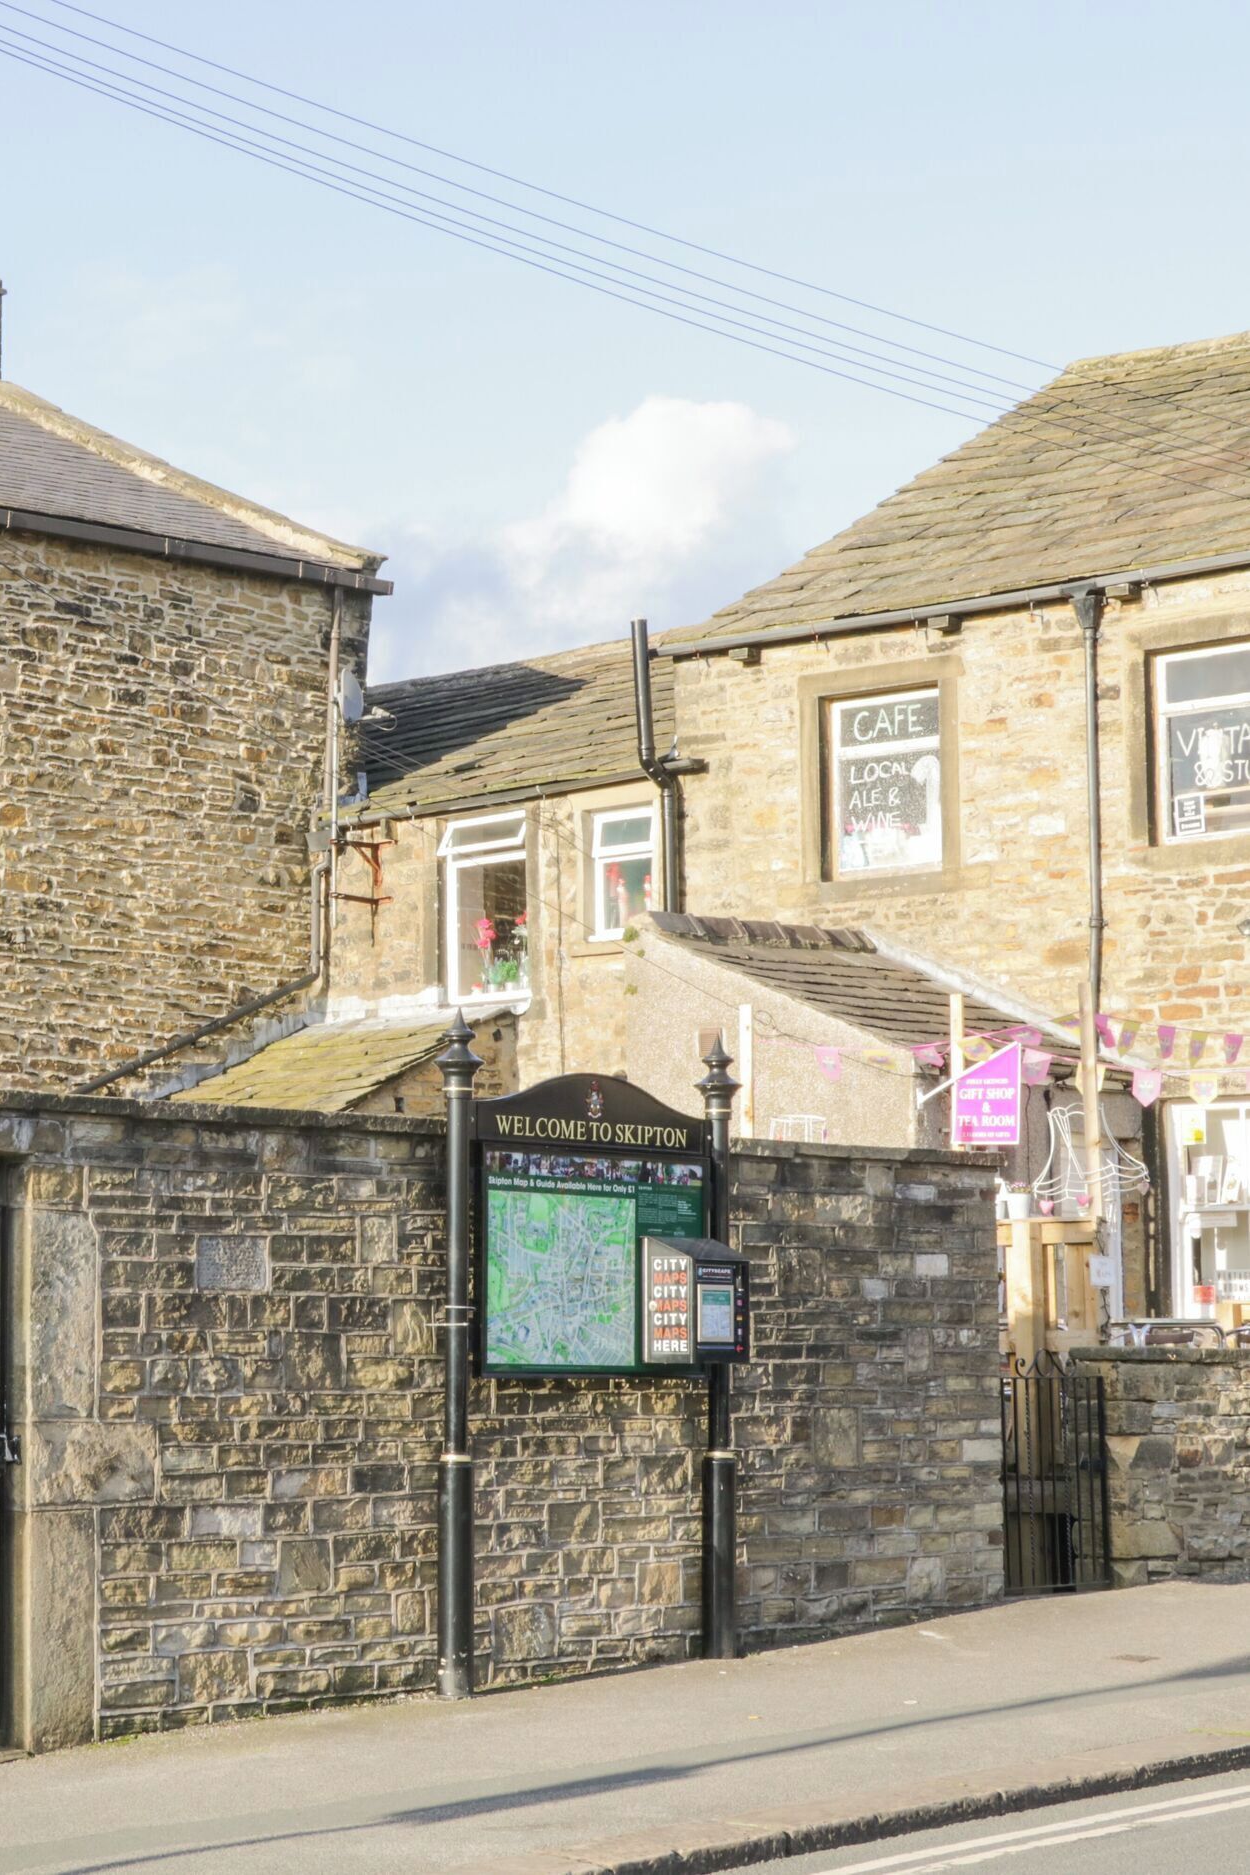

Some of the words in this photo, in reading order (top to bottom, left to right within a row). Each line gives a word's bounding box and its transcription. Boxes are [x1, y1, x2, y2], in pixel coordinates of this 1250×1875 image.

[853, 703, 923, 741] CAFE
[849, 760, 910, 784] LOCAL
[849, 787, 882, 810] ALE
[888, 786, 901, 807] &
[851, 811, 901, 833] WINE
[959, 1087, 984, 1100] GIFT
[986, 1087, 1015, 1100] SHOP
[981, 1101, 991, 1113] &
[958, 1115, 979, 1127] TEA
[981, 1115, 1015, 1127] ROOM
[495, 1114, 587, 1141] WELCOME
[588, 1122, 612, 1142] TO
[615, 1123, 688, 1148] SKIPTON
[488, 1175, 512, 1186] Skipton
[513, 1178, 529, 1188] Map
[530, 1179, 535, 1187] &
[536, 1179, 555, 1188] Guide
[556, 1181, 586, 1191] Available
[587, 1183, 602, 1192] Here
[603, 1183, 612, 1192] for
[613, 1184, 627, 1194] Only
[653, 1258, 687, 1271] CITY
[653, 1272, 687, 1284] MAPS
[653, 1285, 687, 1298] CITY
[653, 1313, 687, 1325] CITY
[653, 1327, 687, 1339] MAPS
[653, 1340, 688, 1352] HERE
